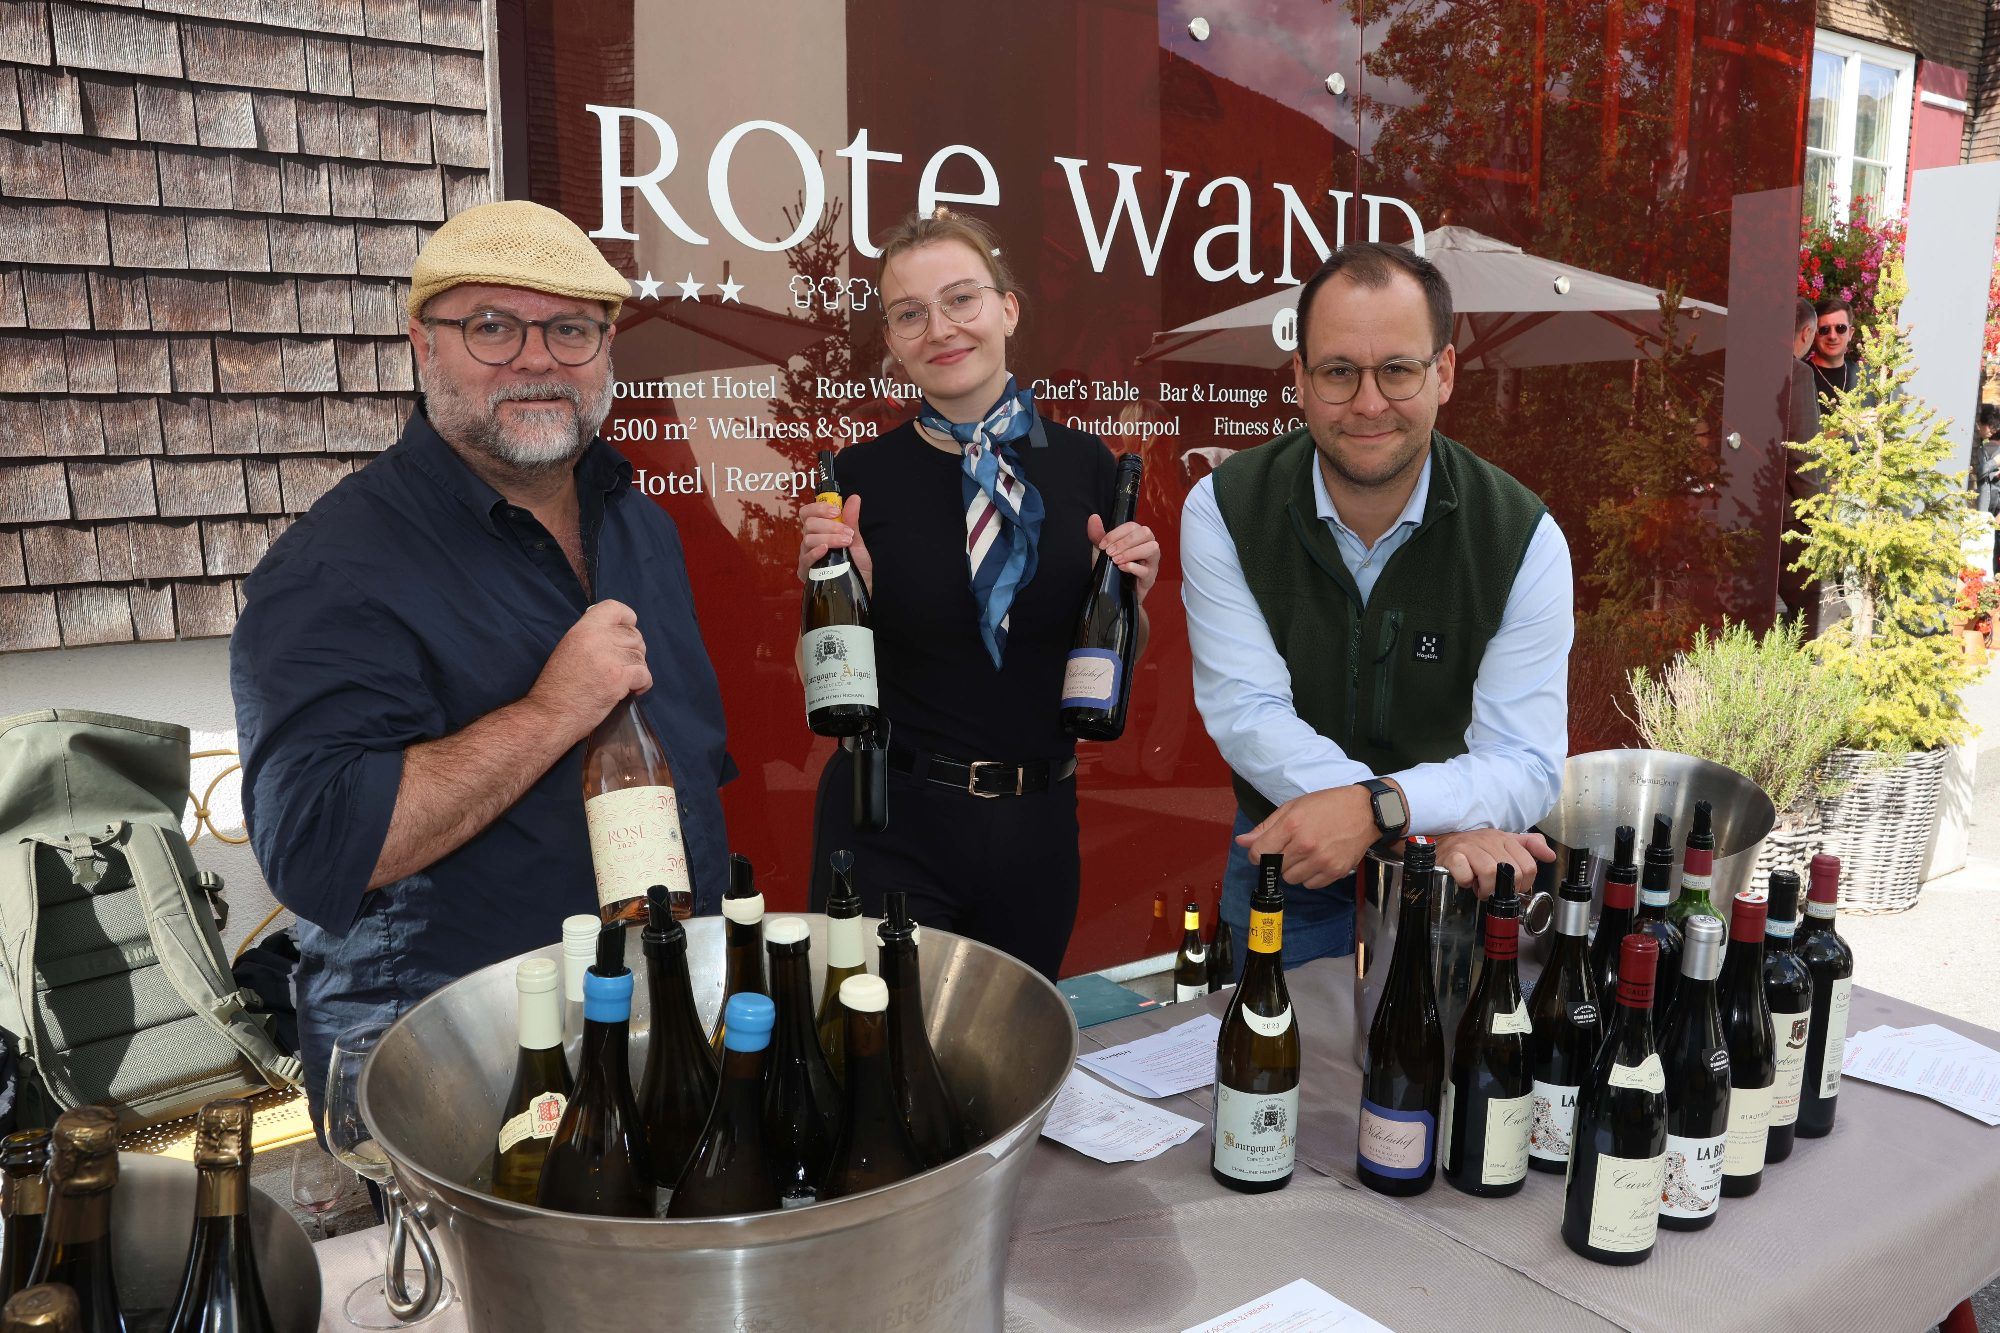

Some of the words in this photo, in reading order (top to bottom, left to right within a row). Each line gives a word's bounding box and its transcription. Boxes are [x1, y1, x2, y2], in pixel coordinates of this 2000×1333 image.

[612, 378, 706, 400] ourmet
[711, 375, 777, 400] Hotel
[815, 377, 866, 399] Rote
[868, 377, 923, 400] Wan
[1091, 381, 1140, 402] Table
[1159, 382, 1189, 402] Bar
[1191, 383, 1205, 402] &
[1208, 383, 1268, 409] Lounge
[596, 417, 657, 442] .500
[707, 416, 811, 440] Wellness
[815, 418, 834, 439] &
[838, 416, 880, 444] Spa
[1066, 415, 1181, 441] Outdoorpool
[1213, 416, 1269, 436] Fitness
[1272, 417, 1285, 436] &
[725, 466, 819, 498] Rezept
[538, 1121, 558, 1134] 202
[1696, 1147, 1711, 1161] LA
